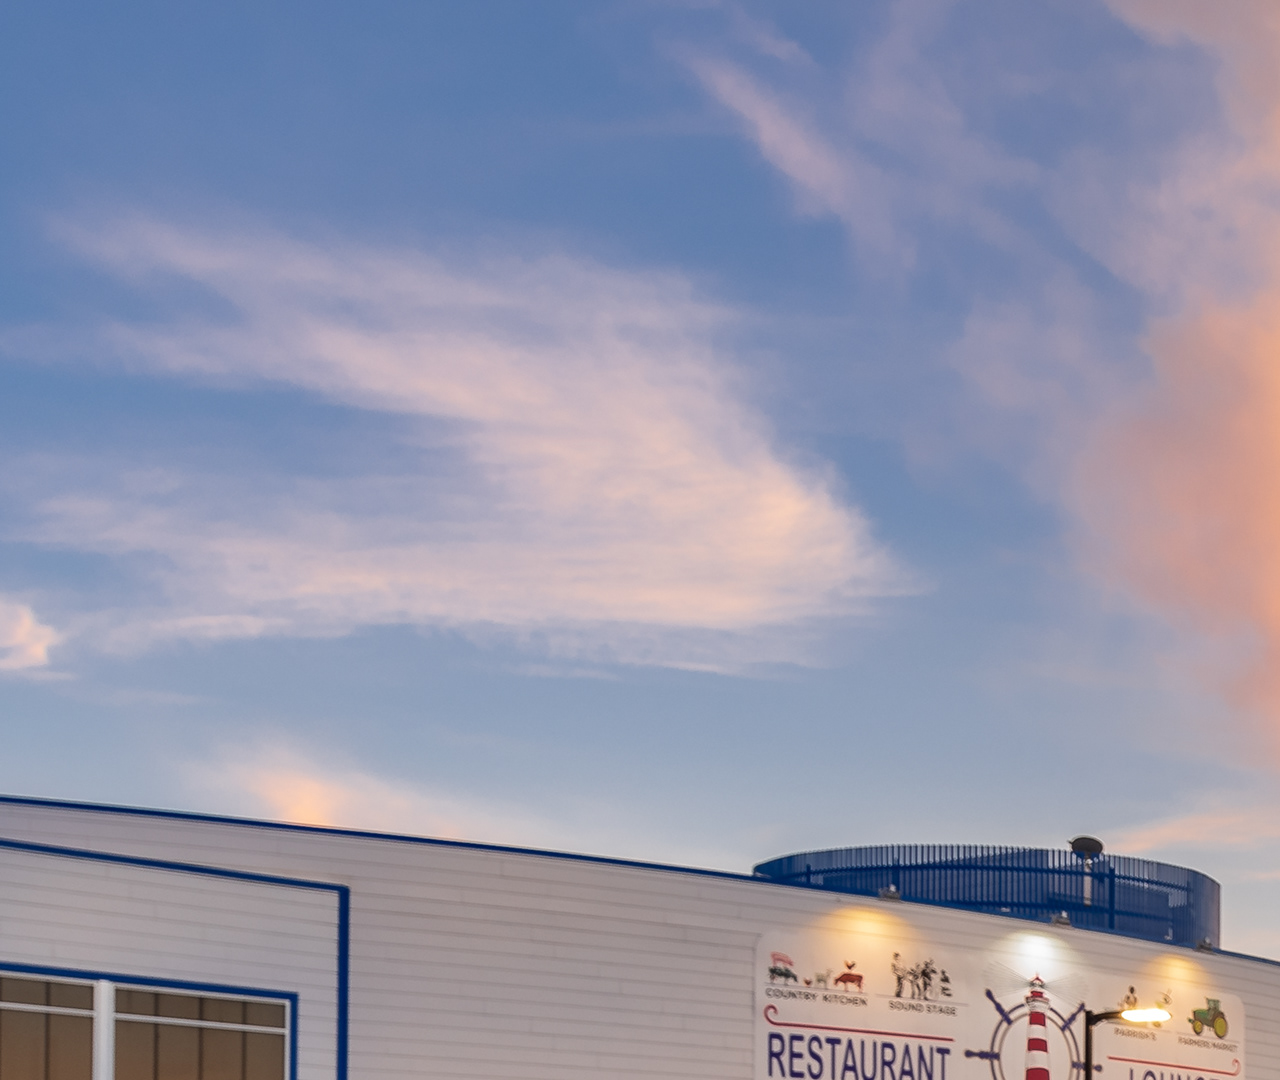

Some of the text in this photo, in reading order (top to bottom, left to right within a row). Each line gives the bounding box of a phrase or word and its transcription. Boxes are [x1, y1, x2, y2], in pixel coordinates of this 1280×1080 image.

[765, 988, 868, 1007] COUNTRY KITCHEN
[888, 1000, 958, 1017] SOUND STAGE
